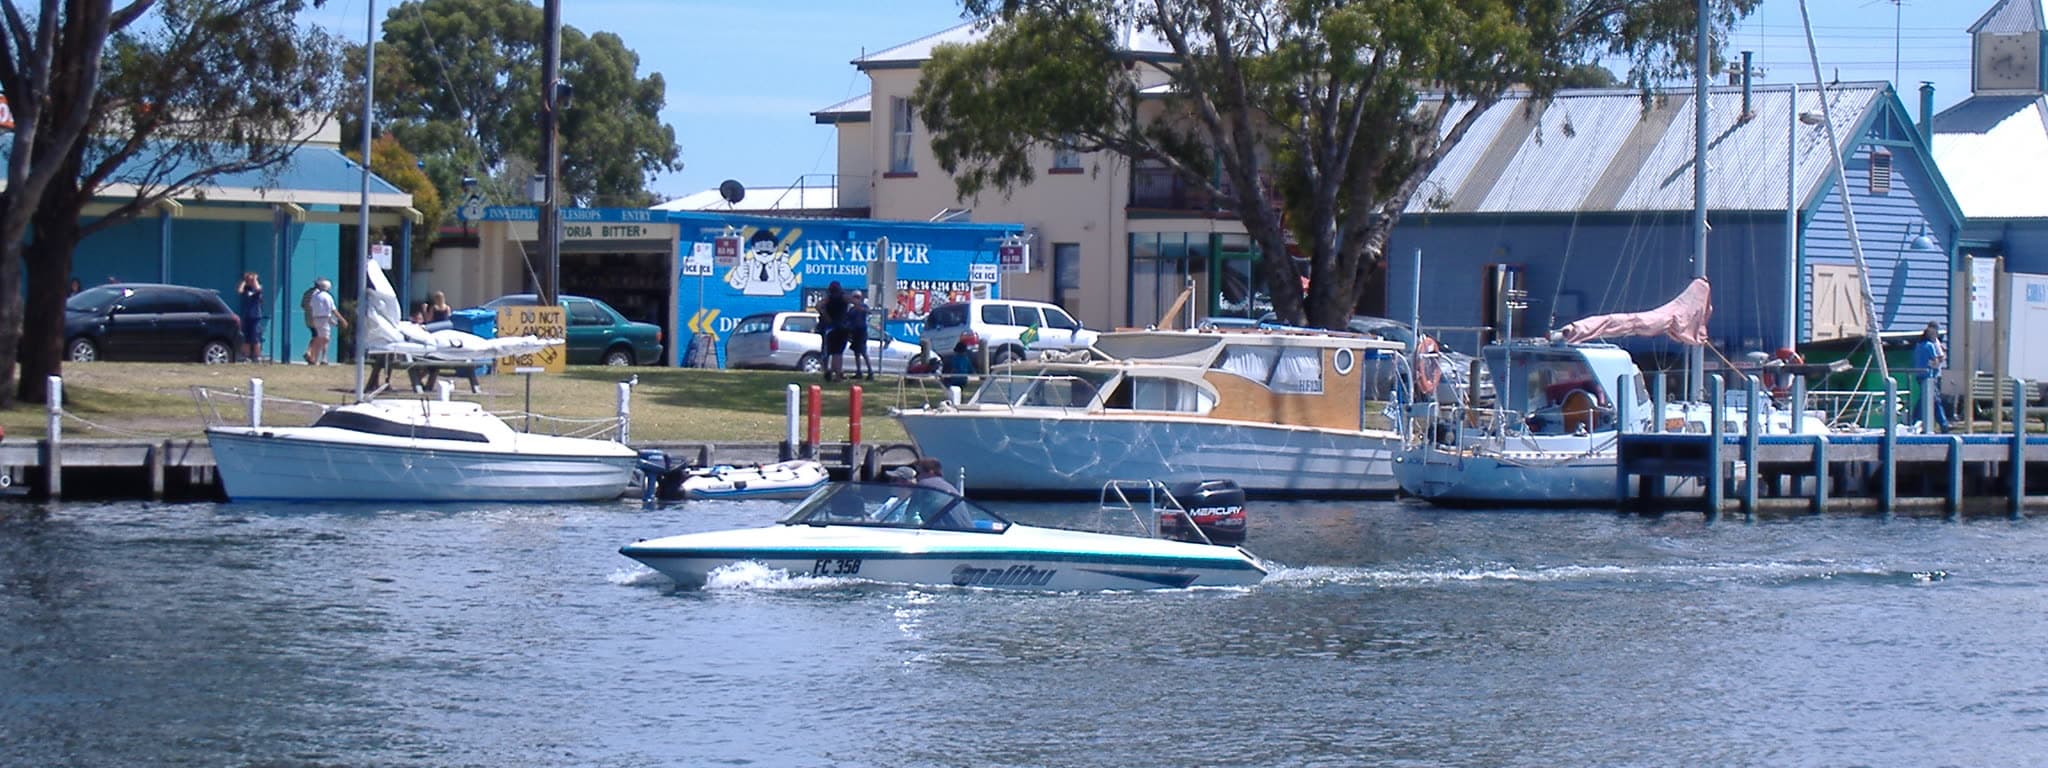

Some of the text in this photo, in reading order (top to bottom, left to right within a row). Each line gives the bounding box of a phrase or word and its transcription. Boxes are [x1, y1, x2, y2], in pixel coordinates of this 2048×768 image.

[621, 210, 651, 222] ENTRY
[564, 225, 641, 238] ORIA BITTER
[806, 239, 930, 265] INN-KEPER
[805, 263, 867, 276] BOTTLESHO
[985, 272, 996, 281] ICE
[520, 312, 561, 324] DO NOT
[522, 325, 564, 340] ANCHOR
[1190, 505, 1242, 517] MERCURY
[813, 559, 862, 575] FC 358
